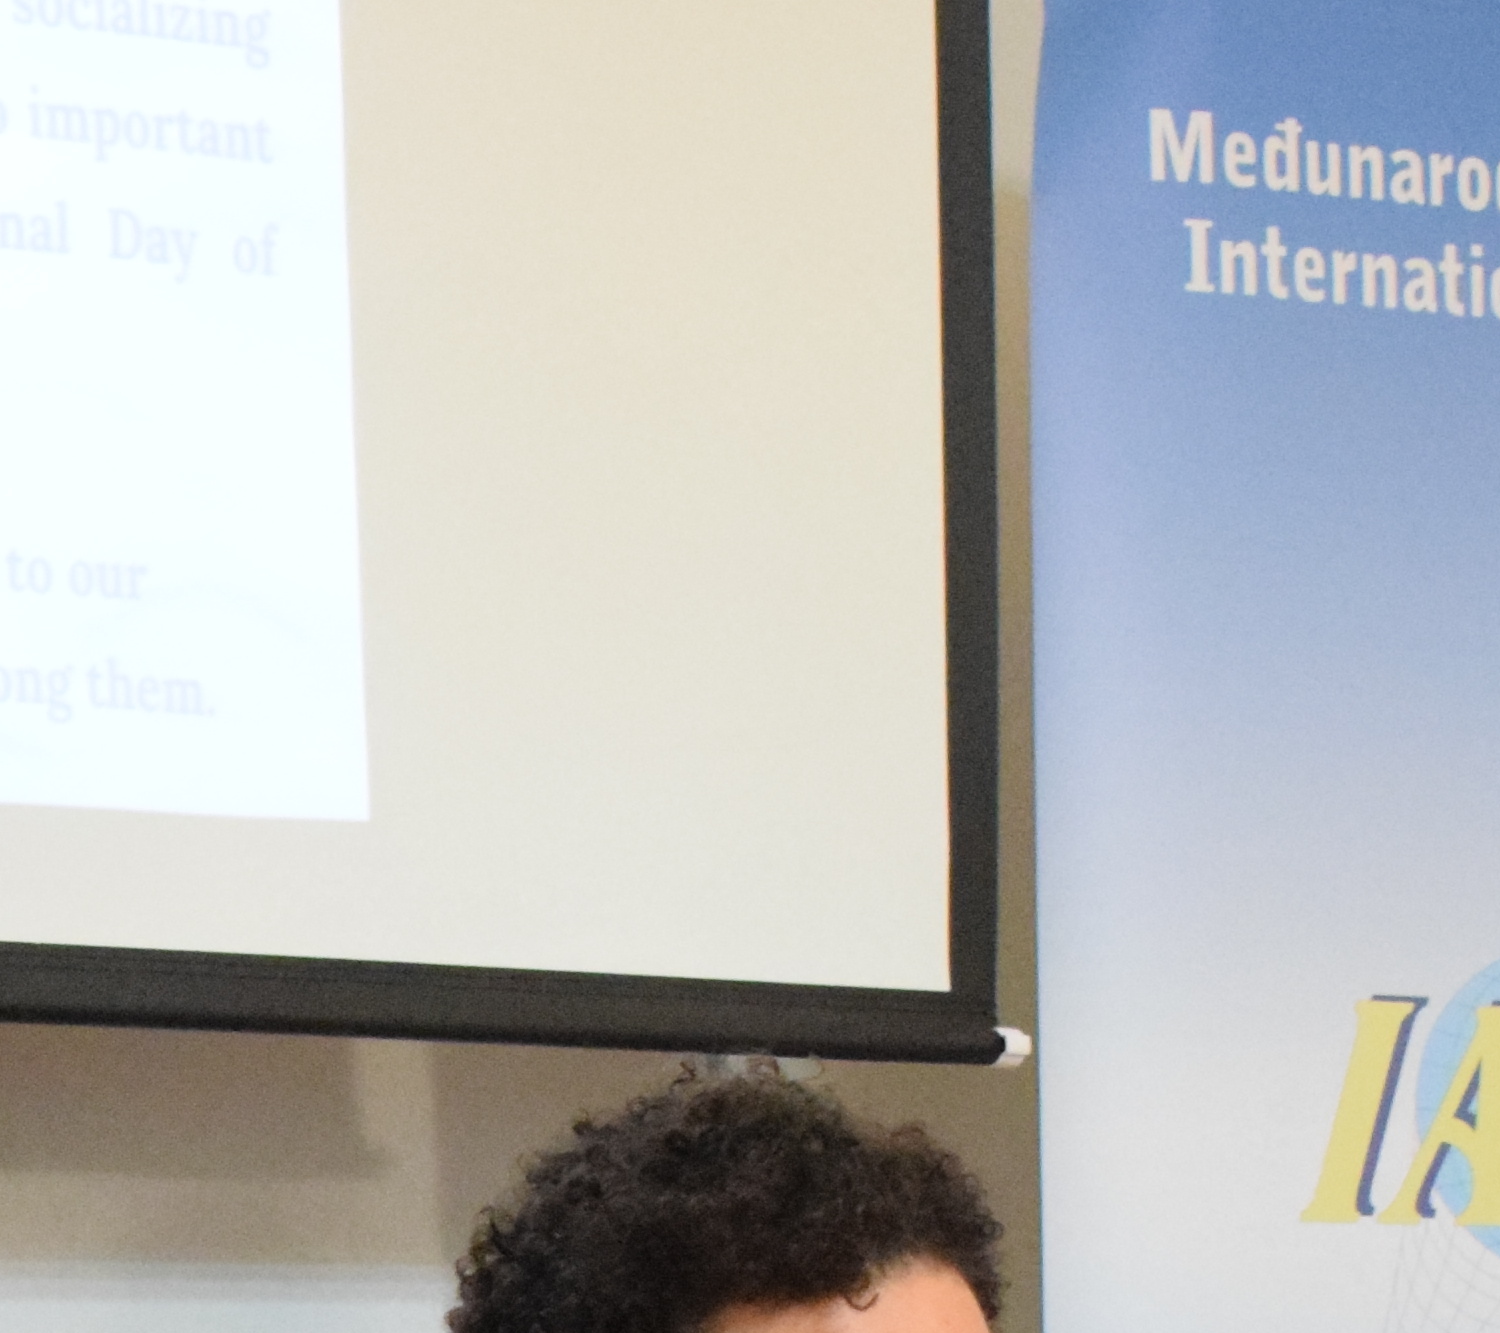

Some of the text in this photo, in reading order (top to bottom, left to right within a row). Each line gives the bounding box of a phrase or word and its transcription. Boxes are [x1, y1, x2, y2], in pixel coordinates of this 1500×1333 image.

[12, 0, 272, 71] socializing
[28, 84, 275, 165] important
[108, 207, 199, 284] Day
[233, 222, 280, 277] of
[5, 549, 54, 596] to
[69, 561, 148, 602] our
[86, 656, 216, 718] them.
